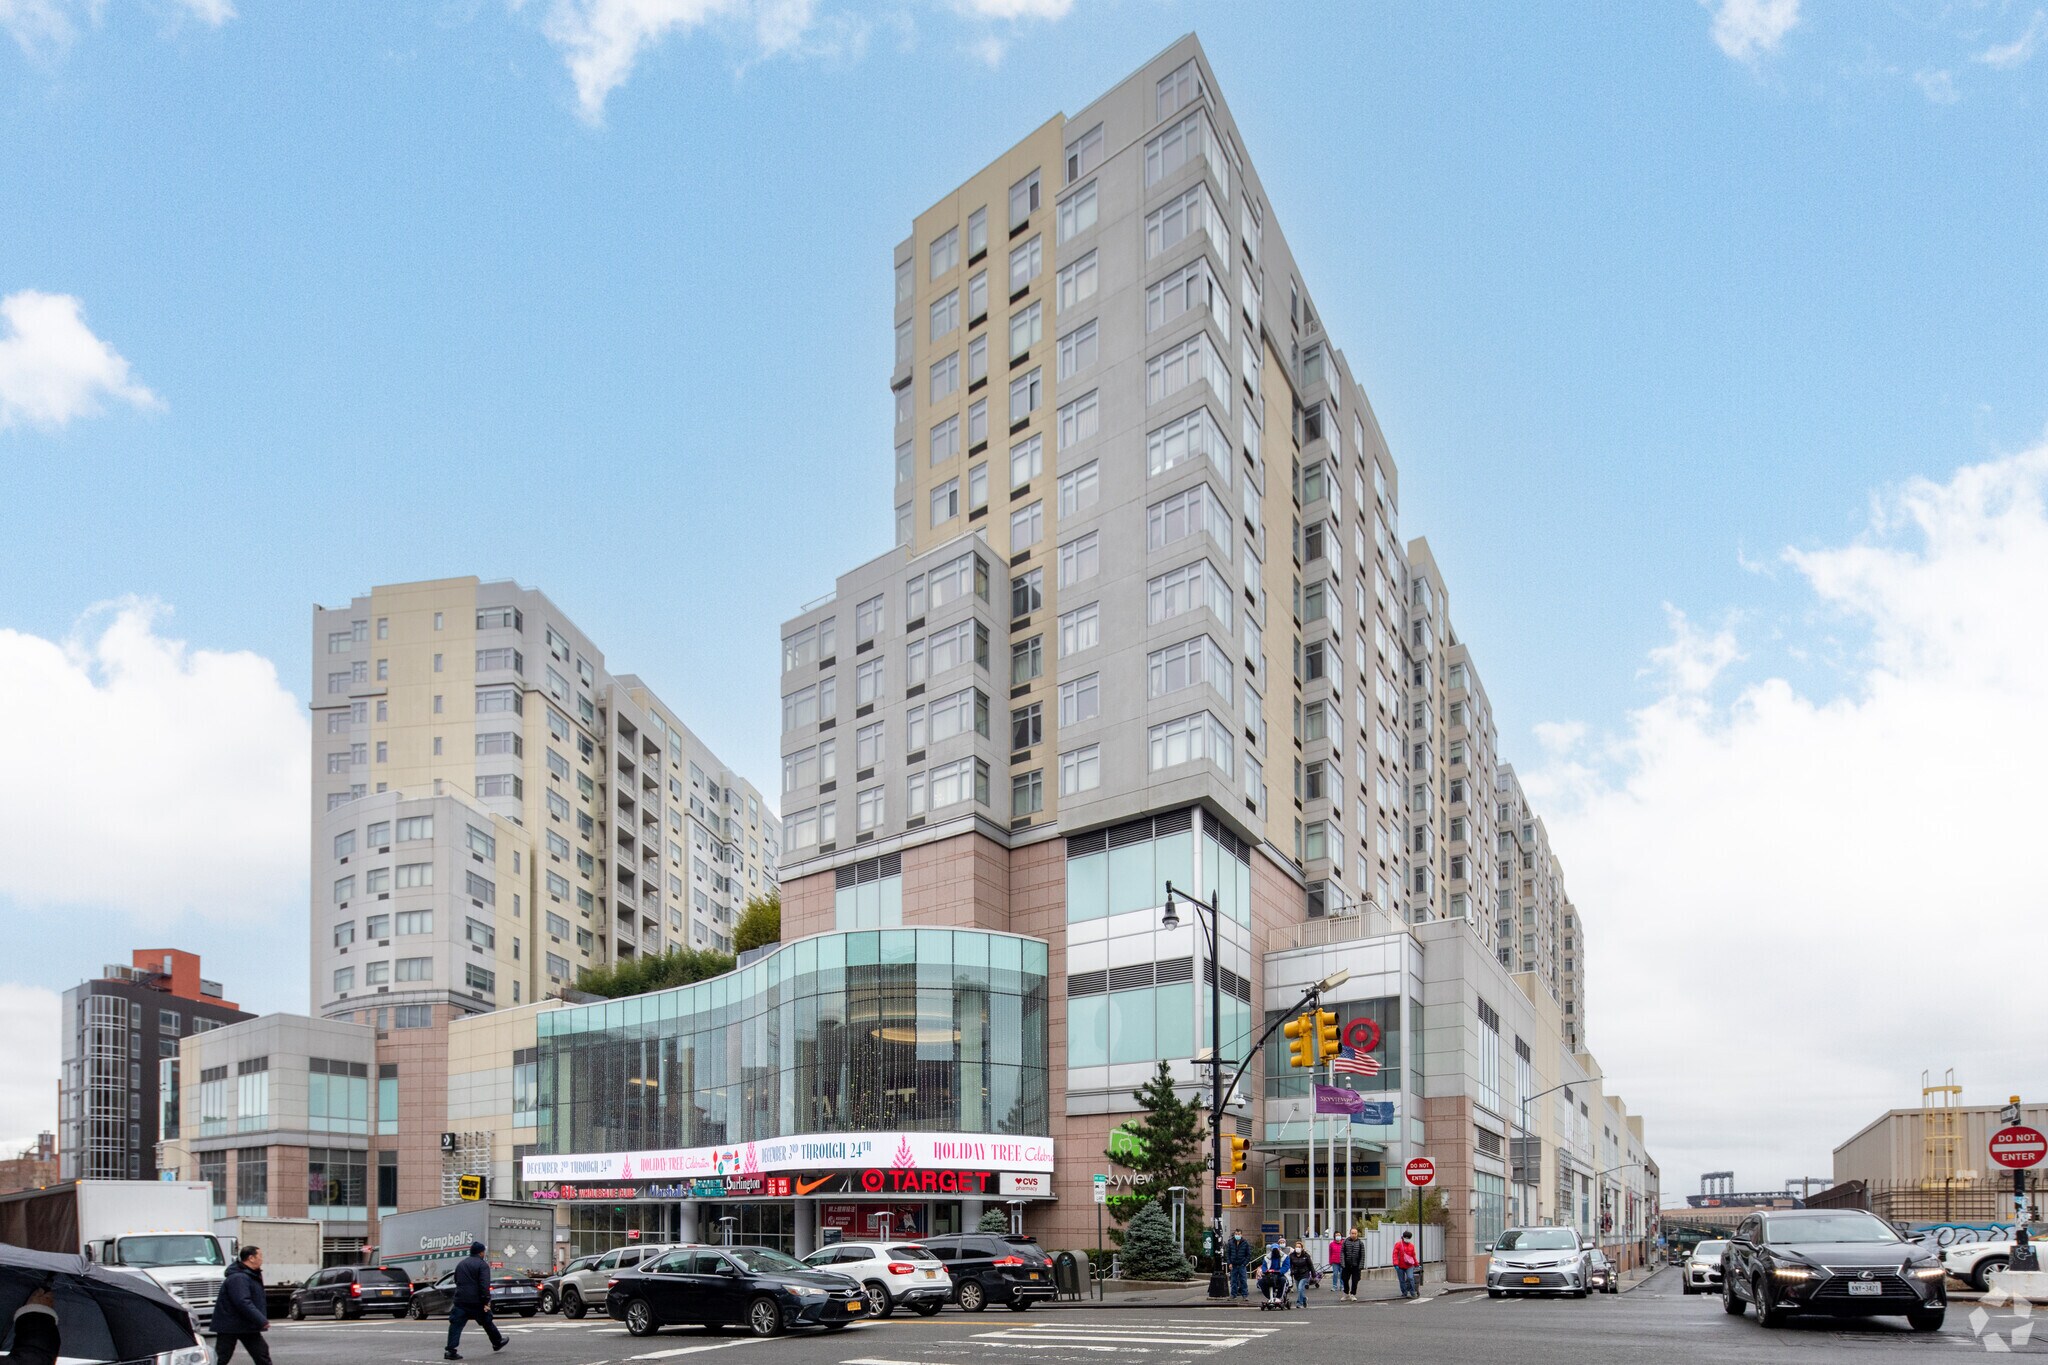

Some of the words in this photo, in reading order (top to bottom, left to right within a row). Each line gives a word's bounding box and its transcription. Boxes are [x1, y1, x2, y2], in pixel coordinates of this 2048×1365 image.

[1998, 1134, 2013, 1142] DO
[2016, 1133, 2037, 1142] NOT
[761, 1145, 787, 1163] DECEMBER
[800, 1141, 846, 1160] THROUGH
[850, 1140, 872, 1158] 24TH
[934, 1141, 987, 1161] HOLIDAY
[991, 1143, 1022, 1162] TREE
[2002, 1152, 2036, 1161] ENTER
[526, 1161, 559, 1175] DECEMBER
[570, 1160, 599, 1174] THROUGH
[640, 1157, 666, 1172] HOLIDAY
[668, 1156, 685, 1171] TREE
[1295, 1167, 1310, 1175] SK
[726, 1175, 761, 1194] Burlington
[778, 1179, 787, 1187] UNI
[889, 1169, 991, 1192] TARGET
[1022, 1177, 1039, 1186] CVS
[578, 1188, 617, 1199] WHOLESALE
[618, 1187, 636, 1199] CLUB
[648, 1183, 687, 1198] Marshalls
[500, 1217, 541, 1226] Campbell's
[420, 1230, 473, 1251] Campbell's
[421, 1249, 471, 1261] EXPRESS
